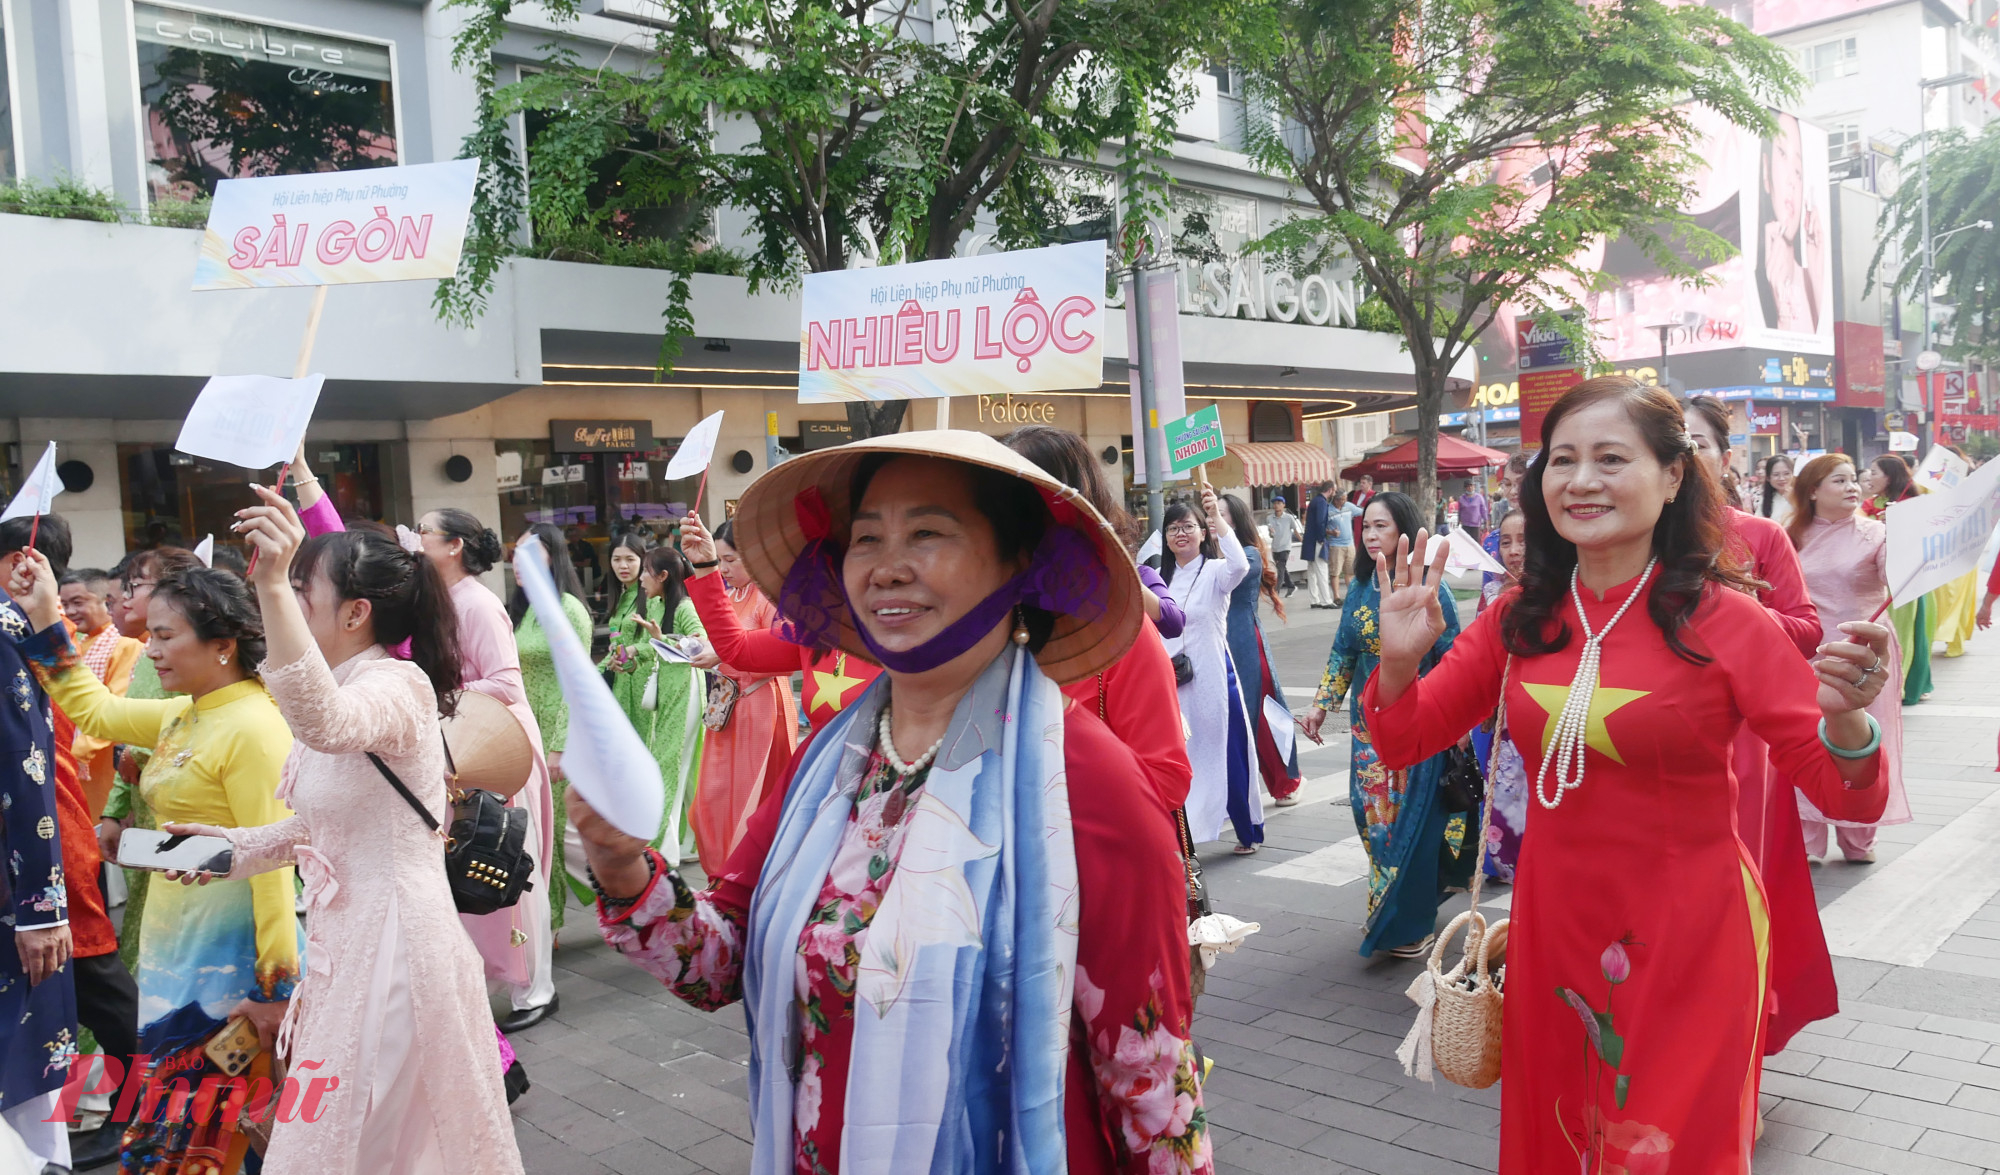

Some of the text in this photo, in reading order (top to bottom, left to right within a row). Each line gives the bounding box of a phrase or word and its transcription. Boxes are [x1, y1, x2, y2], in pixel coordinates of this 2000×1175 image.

[155, 20, 344, 65] calibre
[272, 182, 409, 207] Hội Liên hiệp Phụ nữ Phường
[227, 205, 433, 271] SÀI GÒN
[870, 272, 1025, 305] Hội Liên hiệp Phụ nữ Phường
[1203, 261, 1358, 328] SAIGON
[806, 299, 961, 372] NHIÊU
[974, 286, 1097, 374] LỘC
[1669, 321, 1734, 346] DIOR
[1945, 377, 1962, 394] K
[978, 392, 1056, 423] Palace
[1174, 434, 1217, 462] NHÓM 1
[1380, 462, 1418, 470] HIGHLAN
